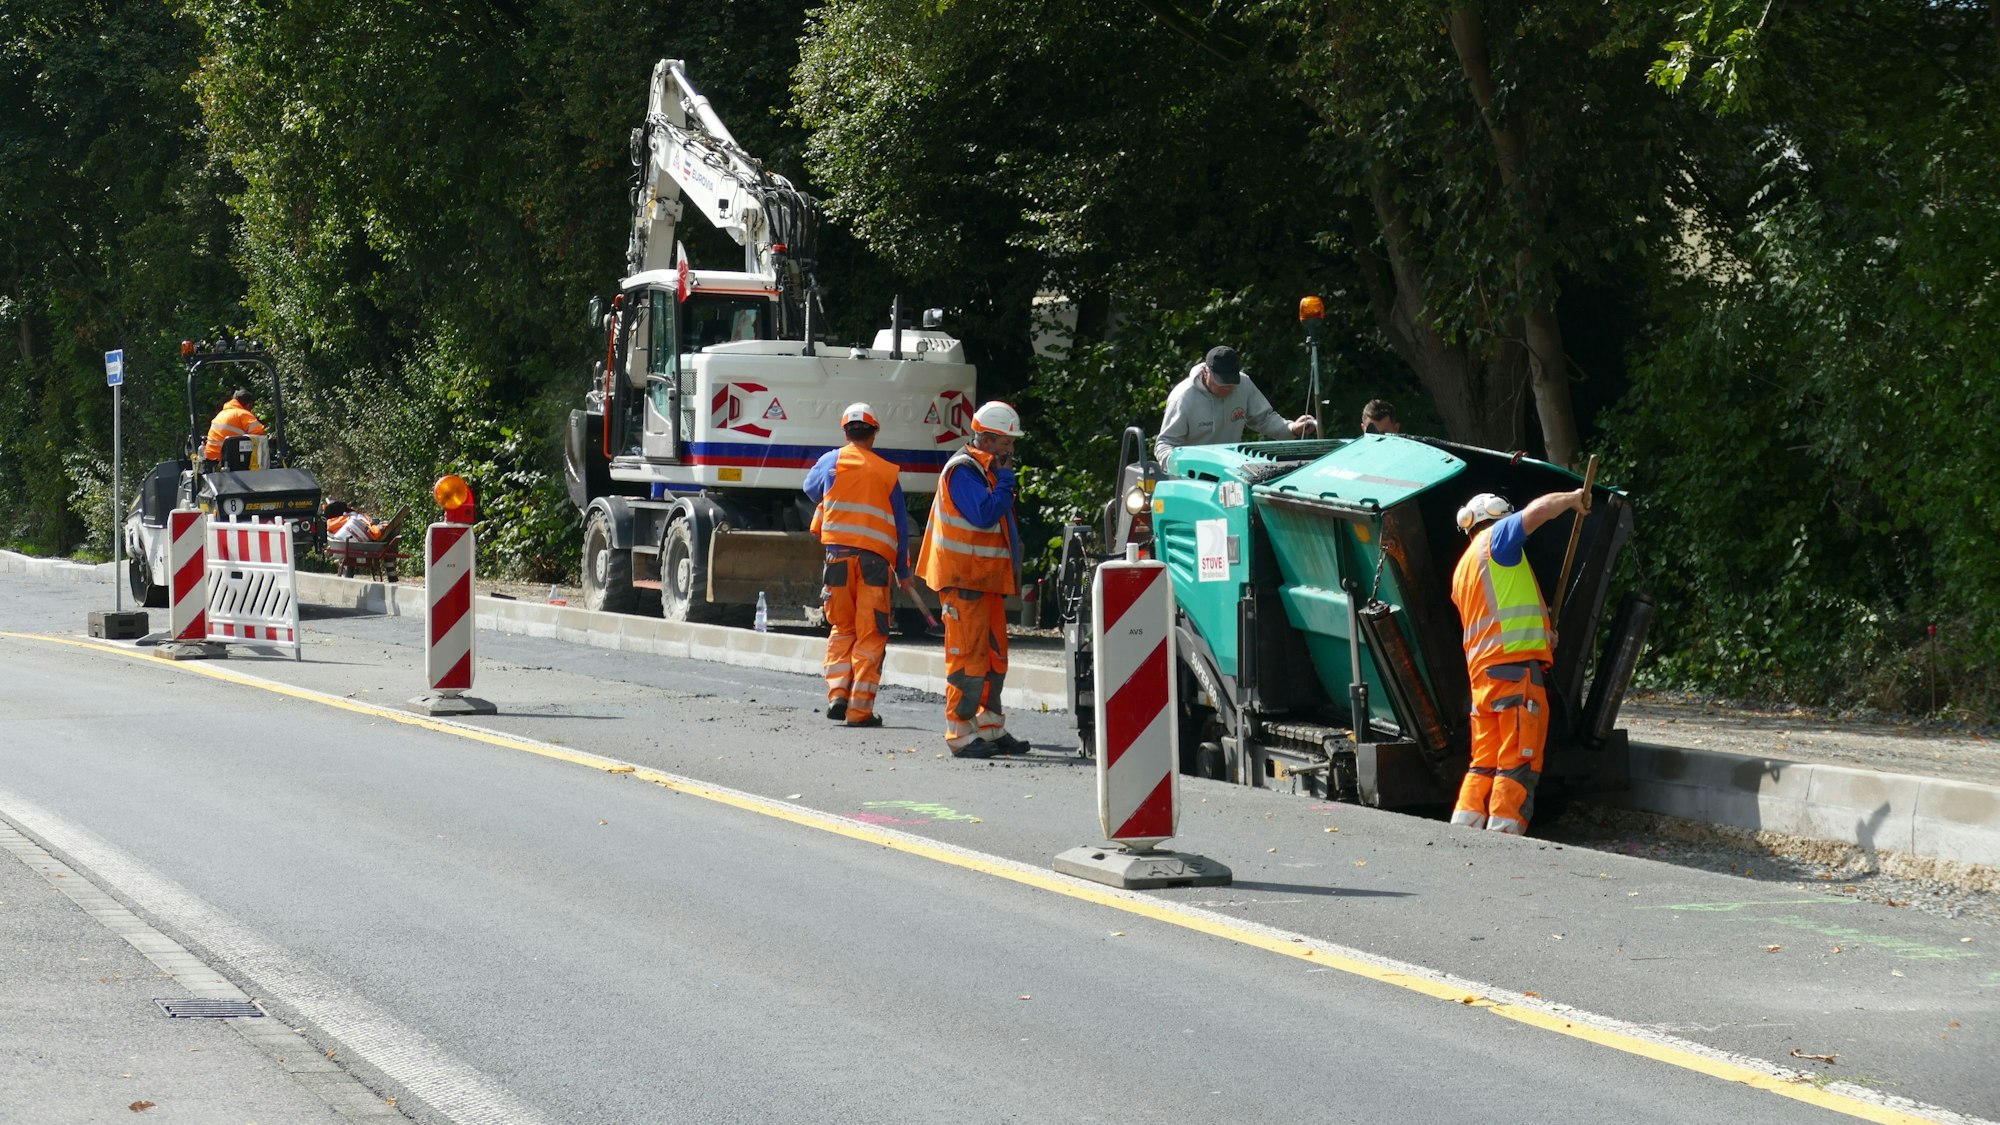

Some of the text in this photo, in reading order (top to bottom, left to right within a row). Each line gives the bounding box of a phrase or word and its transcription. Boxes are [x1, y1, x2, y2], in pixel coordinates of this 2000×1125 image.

[691, 168, 713, 192] EUROVIA
[797, 398, 915, 424] VOVO
[230, 499, 237, 512] 8
[1191, 651, 1210, 690] SUPER
